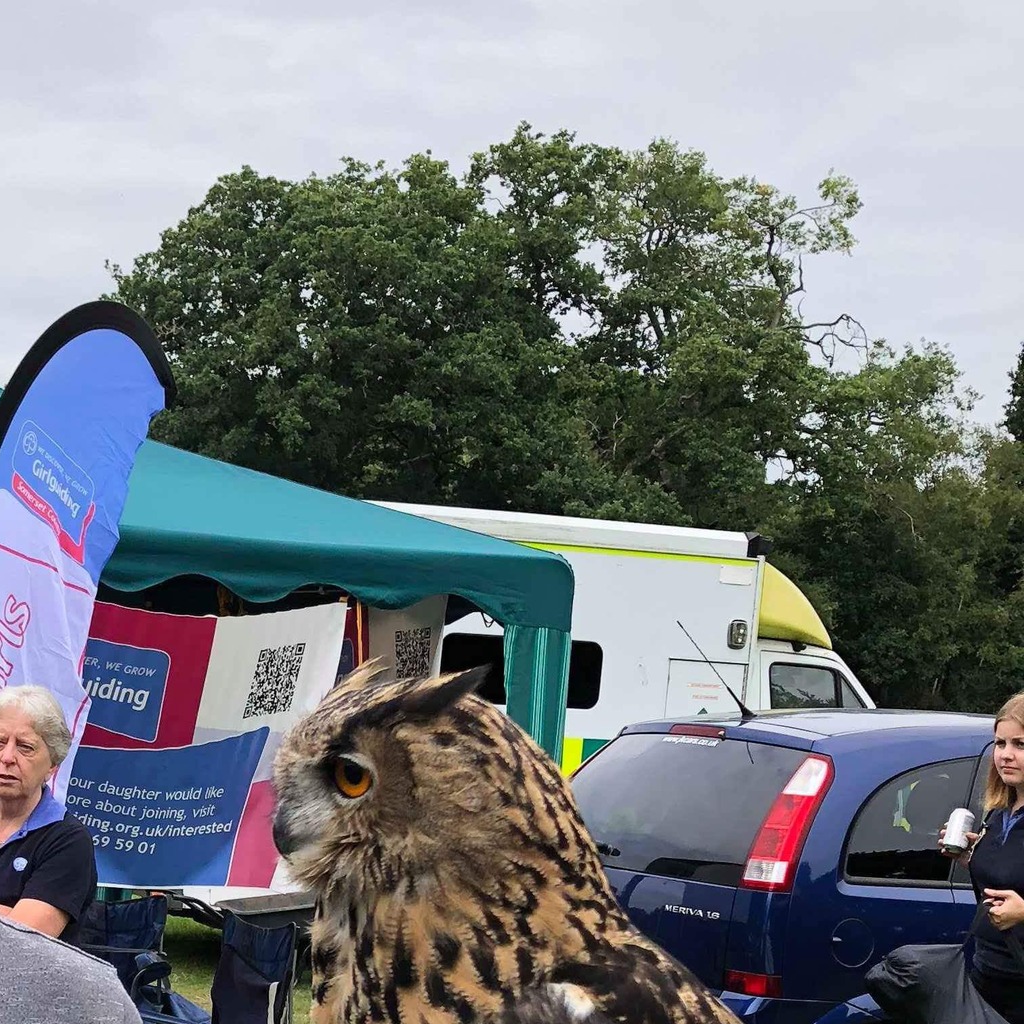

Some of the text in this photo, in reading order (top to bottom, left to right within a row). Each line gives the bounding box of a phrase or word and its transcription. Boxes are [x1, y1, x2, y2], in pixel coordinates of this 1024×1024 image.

[17, 480, 47, 512] Somerset
[32, 459, 81, 518] Girlguiding
[71, 479, 88, 496] GROW
[84, 656, 156, 677] ER, WE GROW
[69, 776, 225, 801] our daughter would like
[67, 794, 216, 822] ore about joining, visit
[114, 838, 135, 852] 59
[138, 841, 156, 855] 01
[664, 904, 703, 918] MERIVA
